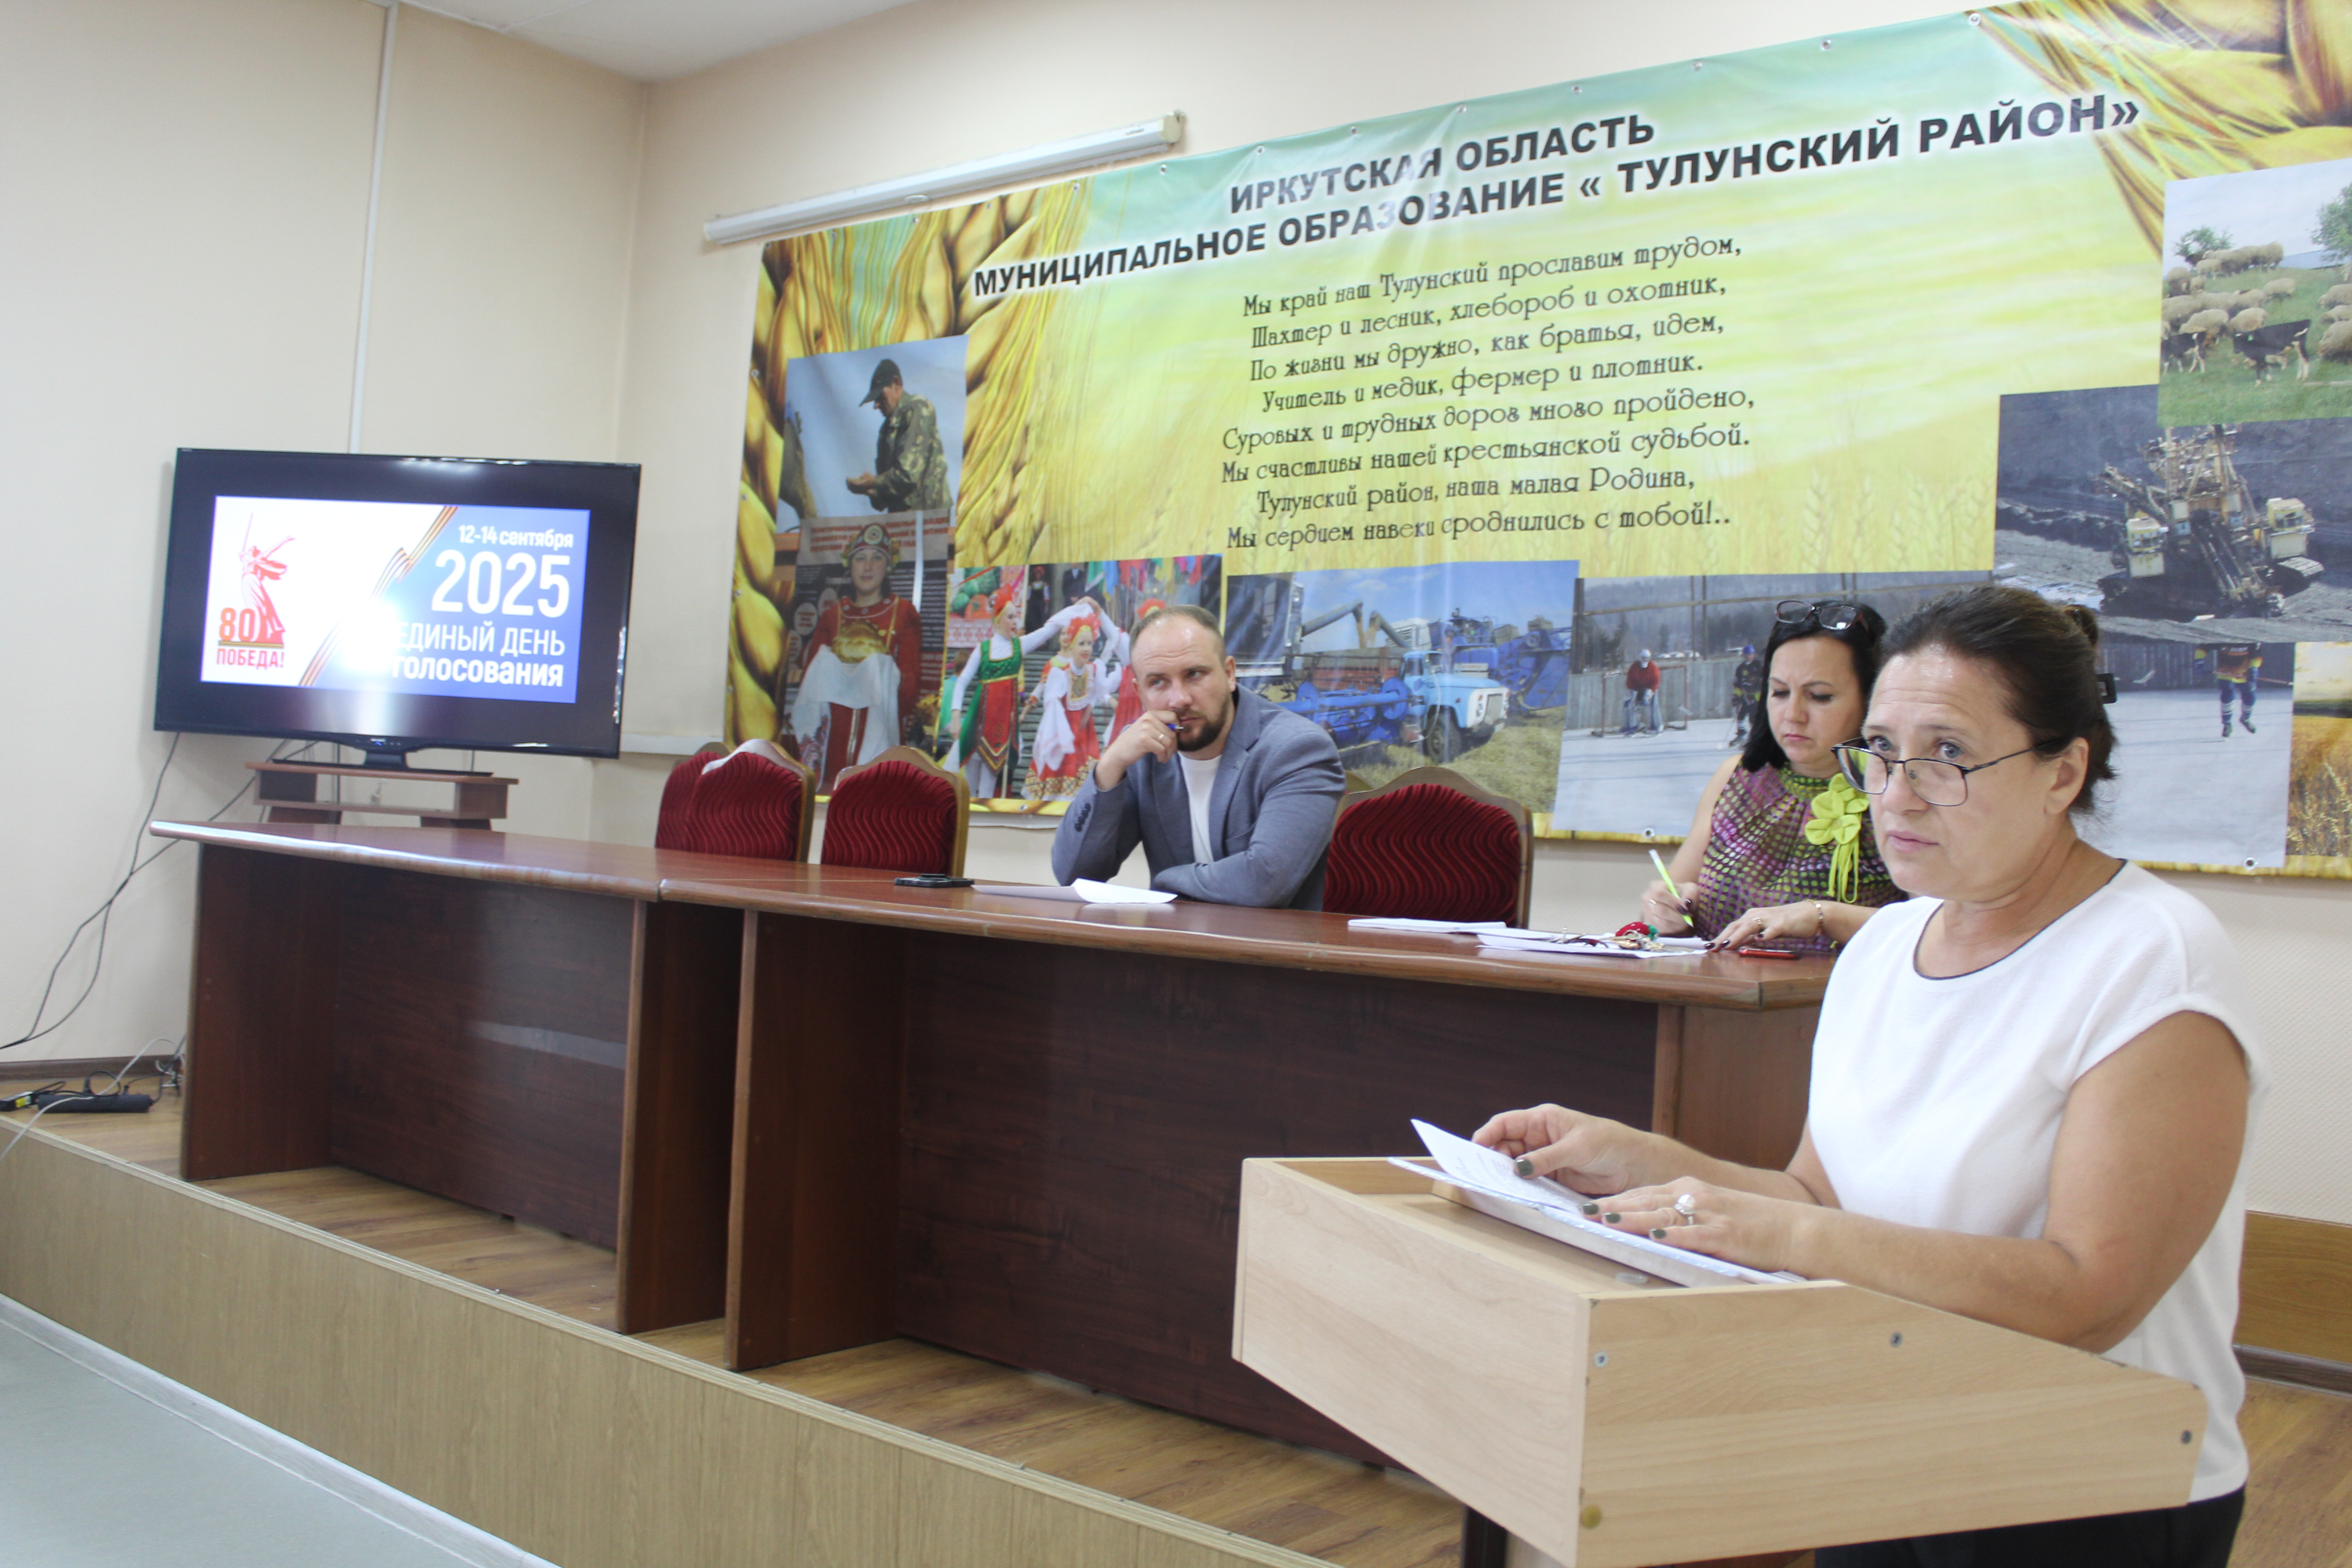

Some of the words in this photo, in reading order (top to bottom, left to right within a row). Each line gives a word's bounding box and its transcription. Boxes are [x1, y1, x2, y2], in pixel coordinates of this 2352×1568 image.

[1231, 147, 1442, 213] ИРКУТСКАЯ
[1456, 114, 1655, 171] ОБЛАСТЬ
[975, 223, 1266, 296] МУНИЦИПАЛЬНОЕ
[1279, 172, 1564, 245] ОБРАЗОВАНИЕ
[1617, 117, 1898, 193] ТУЛУНСКИЙ
[1920, 94, 2139, 153] РАЙОН»
[1243, 294, 1271, 316] Мы
[1280, 285, 1327, 316] край
[1335, 284, 1371, 303] наш
[1381, 261, 1488, 301] Тулунский
[1498, 250, 1623, 285] прославим
[1634, 236, 1741, 270] трудом,
[1251, 324, 1332, 348] Шахтер
[1340, 319, 1351, 335] и
[1361, 308, 1441, 333] лесник,
[1450, 285, 1574, 320] хлебороб
[1585, 290, 1597, 306] и
[1608, 277, 1726, 303] охотник,
[1250, 359, 1277, 381] По
[1284, 354, 1345, 377] жизни
[1354, 351, 1380, 368] мы
[1388, 339, 1480, 368] дружно,
[1491, 333, 1529, 352] как
[1540, 323, 1641, 353] братья,
[1654, 313, 1723, 336] идем,
[1263, 389, 1346, 412] Учитель
[1355, 387, 1364, 403] и
[1372, 377, 1444, 399] медик,
[1451, 367, 1559, 396] фермер
[1570, 364, 1581, 380] и
[1591, 354, 1703, 379] плотник.
[1223, 426, 1314, 455] Суровых
[1323, 425, 1333, 440] и
[1341, 413, 1437, 442] трудных
[1444, 406, 1519, 430] дорог
[1529, 401, 1603, 421] много
[1614, 387, 1754, 421] пройдено,
[1222, 461, 1249, 482] Мы
[1256, 456, 1362, 479] счастливы
[1371, 444, 1437, 469] нашей
[1444, 430, 1621, 468] крестьянской
[1632, 422, 1749, 459] судьбой.
[1258, 485, 1357, 519] Тулунский
[1367, 482, 1438, 511] район,
[1447, 479, 1499, 498] наша
[1510, 476, 1580, 495] малая
[1589, 466, 1695, 490] Родина,
[459, 525, 497, 544] 12-14
[499, 529, 573, 550] сентября
[1227, 526, 1256, 548] Мы
[1265, 523, 1354, 551] сердцем
[1363, 521, 1435, 540] навеки
[1442, 511, 1584, 539] сроднились
[1595, 512, 1609, 529] с
[1619, 500, 1730, 528] тобой!..
[431, 549, 570, 618] 2025
[219, 608, 256, 642] 80
[396, 620, 495, 652] ЕДИНЫЙ
[500, 627, 565, 657] ДЕНЬ
[216, 648, 284, 669] ПОБЕДА!
